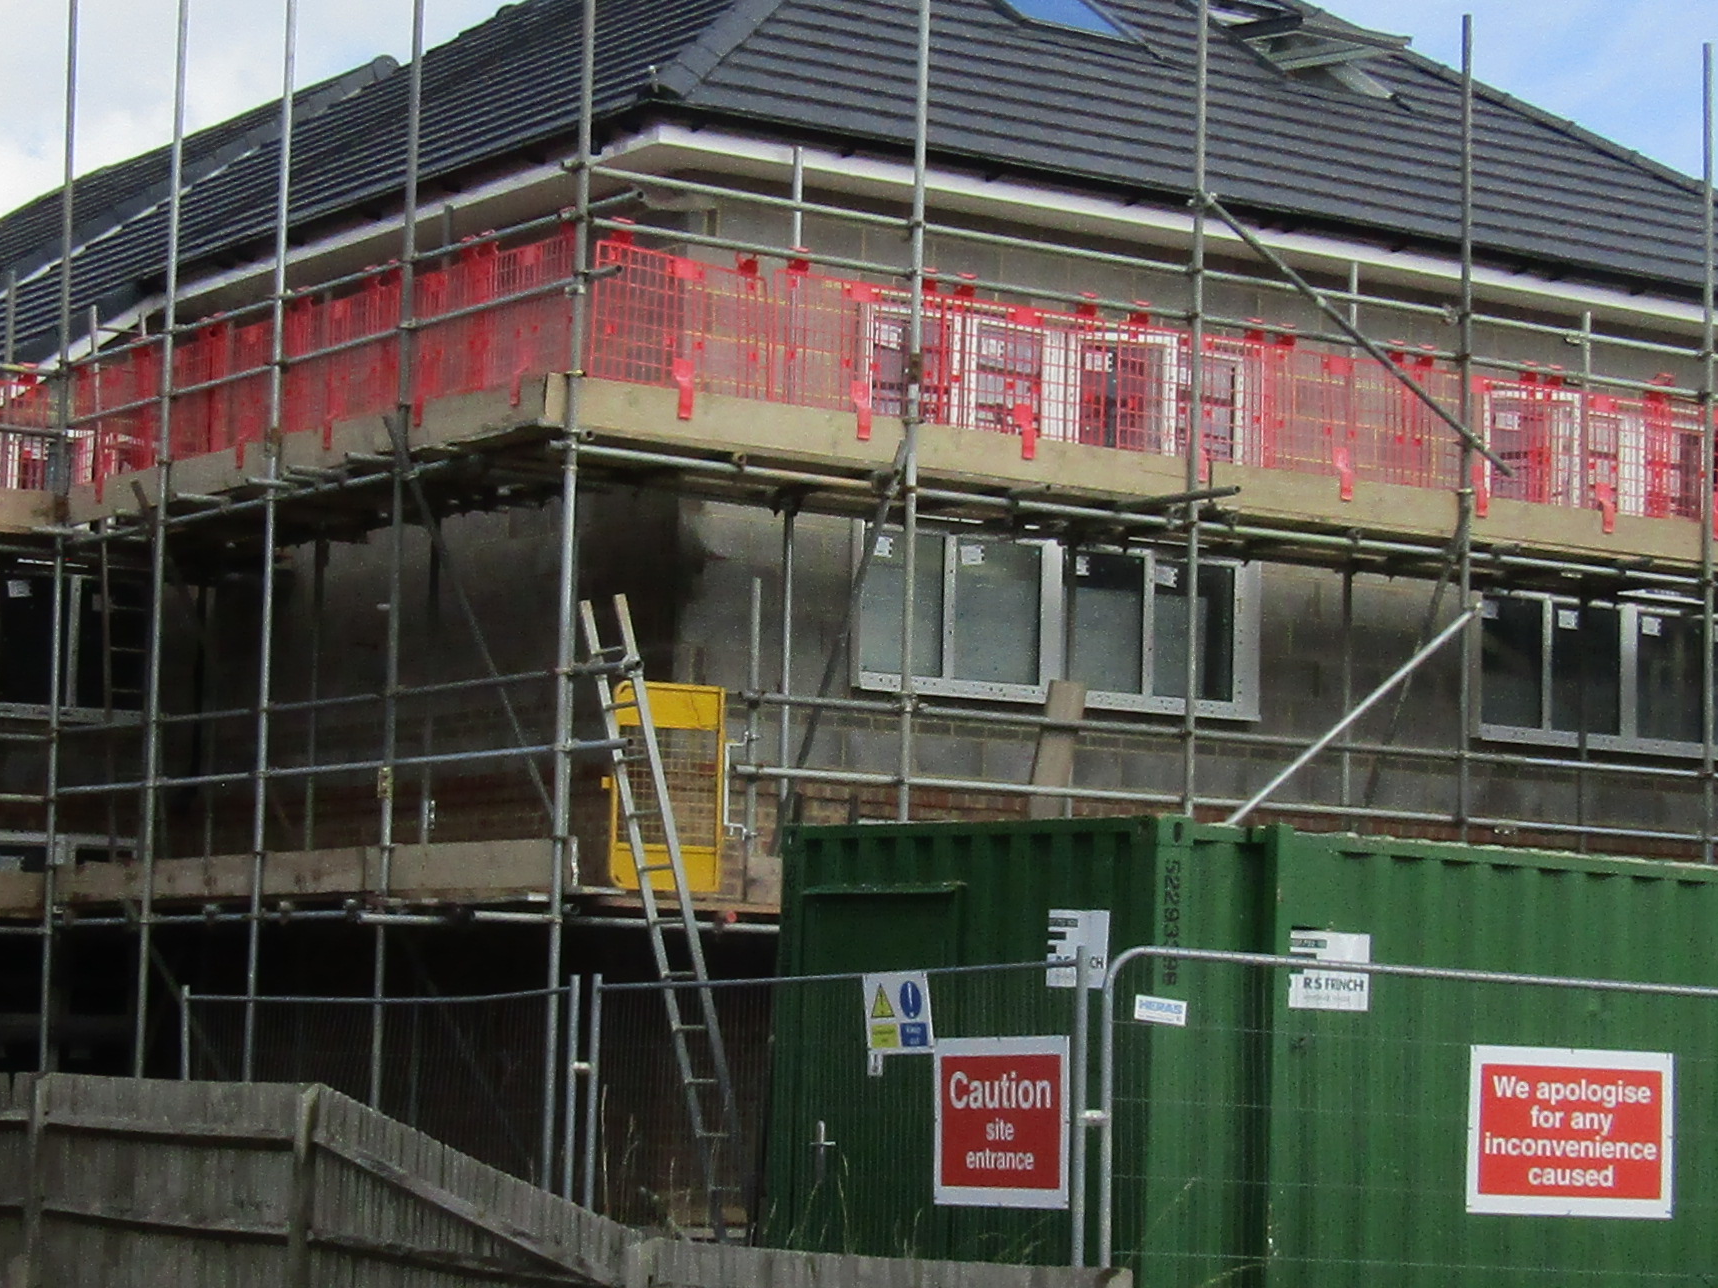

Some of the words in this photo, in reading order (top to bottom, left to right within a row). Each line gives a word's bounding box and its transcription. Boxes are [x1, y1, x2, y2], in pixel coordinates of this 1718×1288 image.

[949, 1070, 1052, 1110] Caution
[1492, 1075, 1531, 1100] We
[1535, 1078, 1652, 1108] apologise
[985, 1117, 1015, 1141] site
[1530, 1105, 1566, 1128] for
[1569, 1110, 1614, 1136] any
[965, 1148, 1035, 1171] entrance
[1483, 1132, 1658, 1161] inconvenience
[1527, 1164, 1615, 1188] caused
